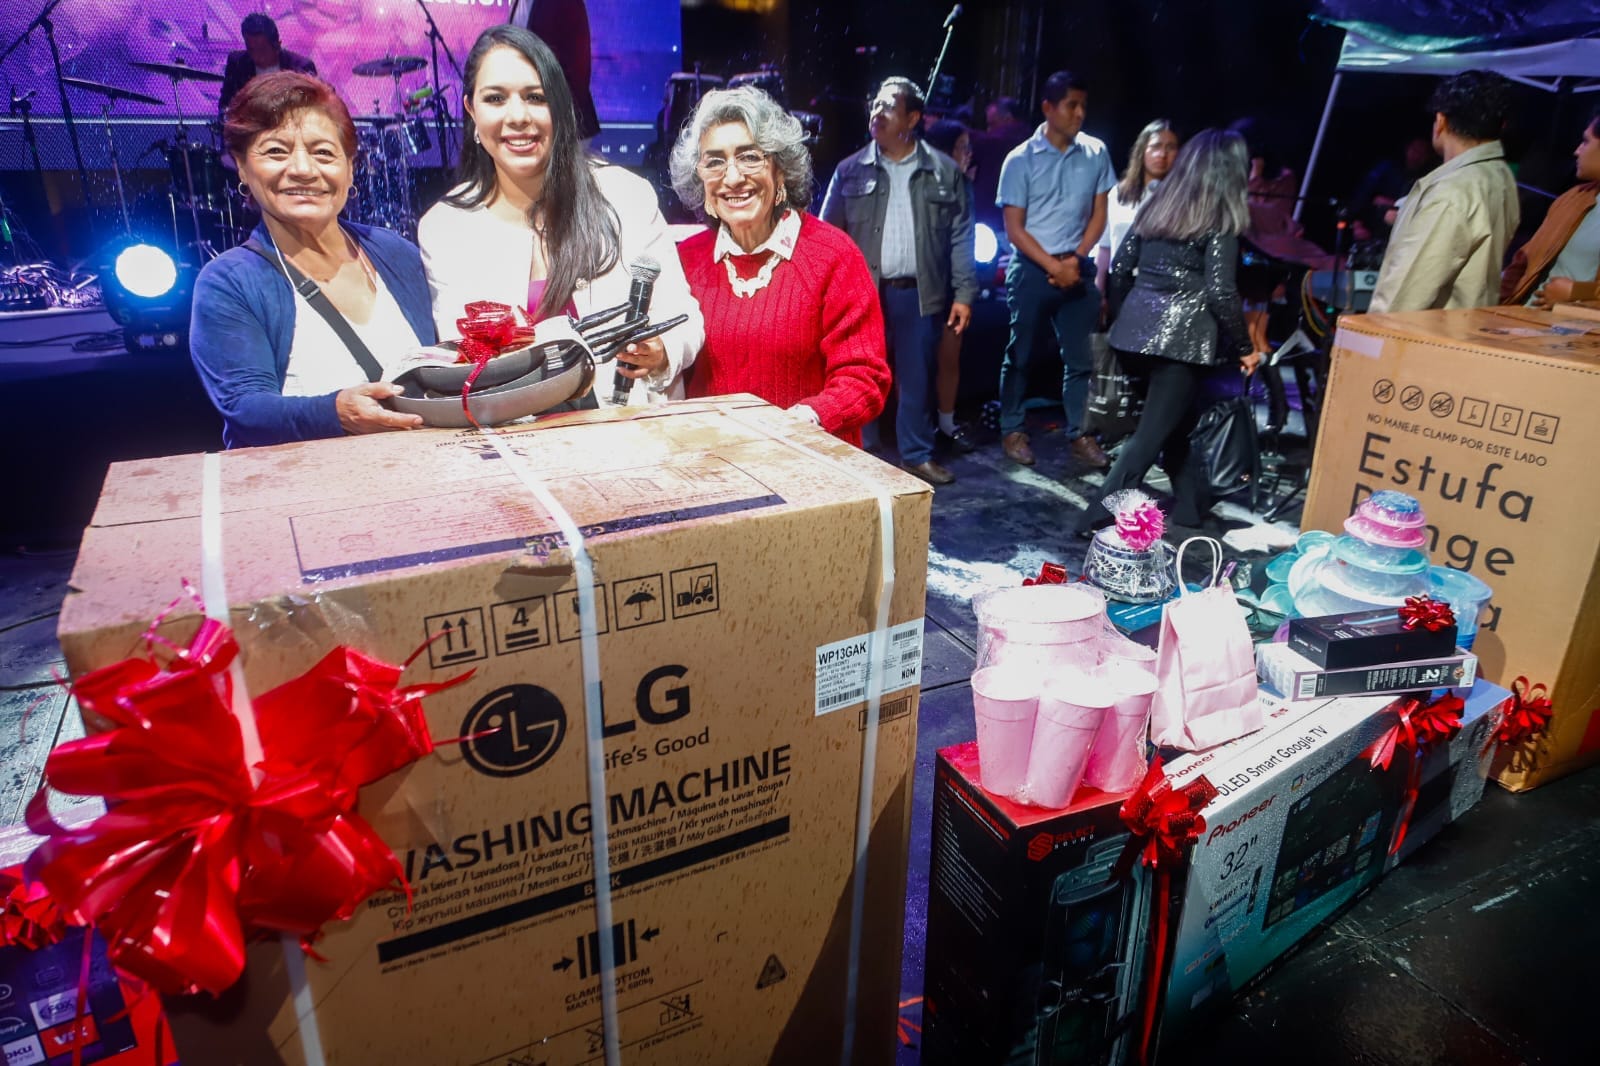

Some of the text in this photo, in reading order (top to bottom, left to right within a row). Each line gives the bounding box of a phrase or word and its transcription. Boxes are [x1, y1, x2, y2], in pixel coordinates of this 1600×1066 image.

[1366, 413, 1548, 467] NO MANEJE CLAMP POR ESTE LADO
[1358, 431, 1535, 523] Estufa
[1350, 482, 1515, 576] nge
[512, 607, 529, 627] 4
[818, 641, 867, 665] WP13GAK
[901, 667, 916, 680] NOM
[592, 663, 692, 740] LG
[603, 726, 710, 771] ife's Good
[1165, 753, 1216, 782] Pioneer
[1246, 755, 1281, 778] Smart
[1276, 735, 1316, 758] Google
[1308, 725, 1328, 738] TV
[609, 743, 791, 826] MACHINE
[470, 860, 520, 880] Lavadora
[531, 843, 579, 862] Lavatrice
[677, 801, 716, 819] Máquina
[718, 798, 729, 806] de
[731, 789, 755, 803] Lavar
[757, 779, 784, 795] Roupa
[1206, 793, 1279, 847] Pioneer
[387, 888, 470, 919] Стральная
[473, 871, 525, 894] машина
[535, 859, 568, 875] Pralka
[631, 826, 677, 847] машина
[700, 809, 729, 826] yuvish
[731, 797, 773, 815] mashinasi
[1220, 834, 1258, 880] 32"
[465, 889, 517, 911] машина
[528, 875, 560, 892] Mesin
[561, 868, 582, 882] cuci
[583, 875, 621, 896] BK
